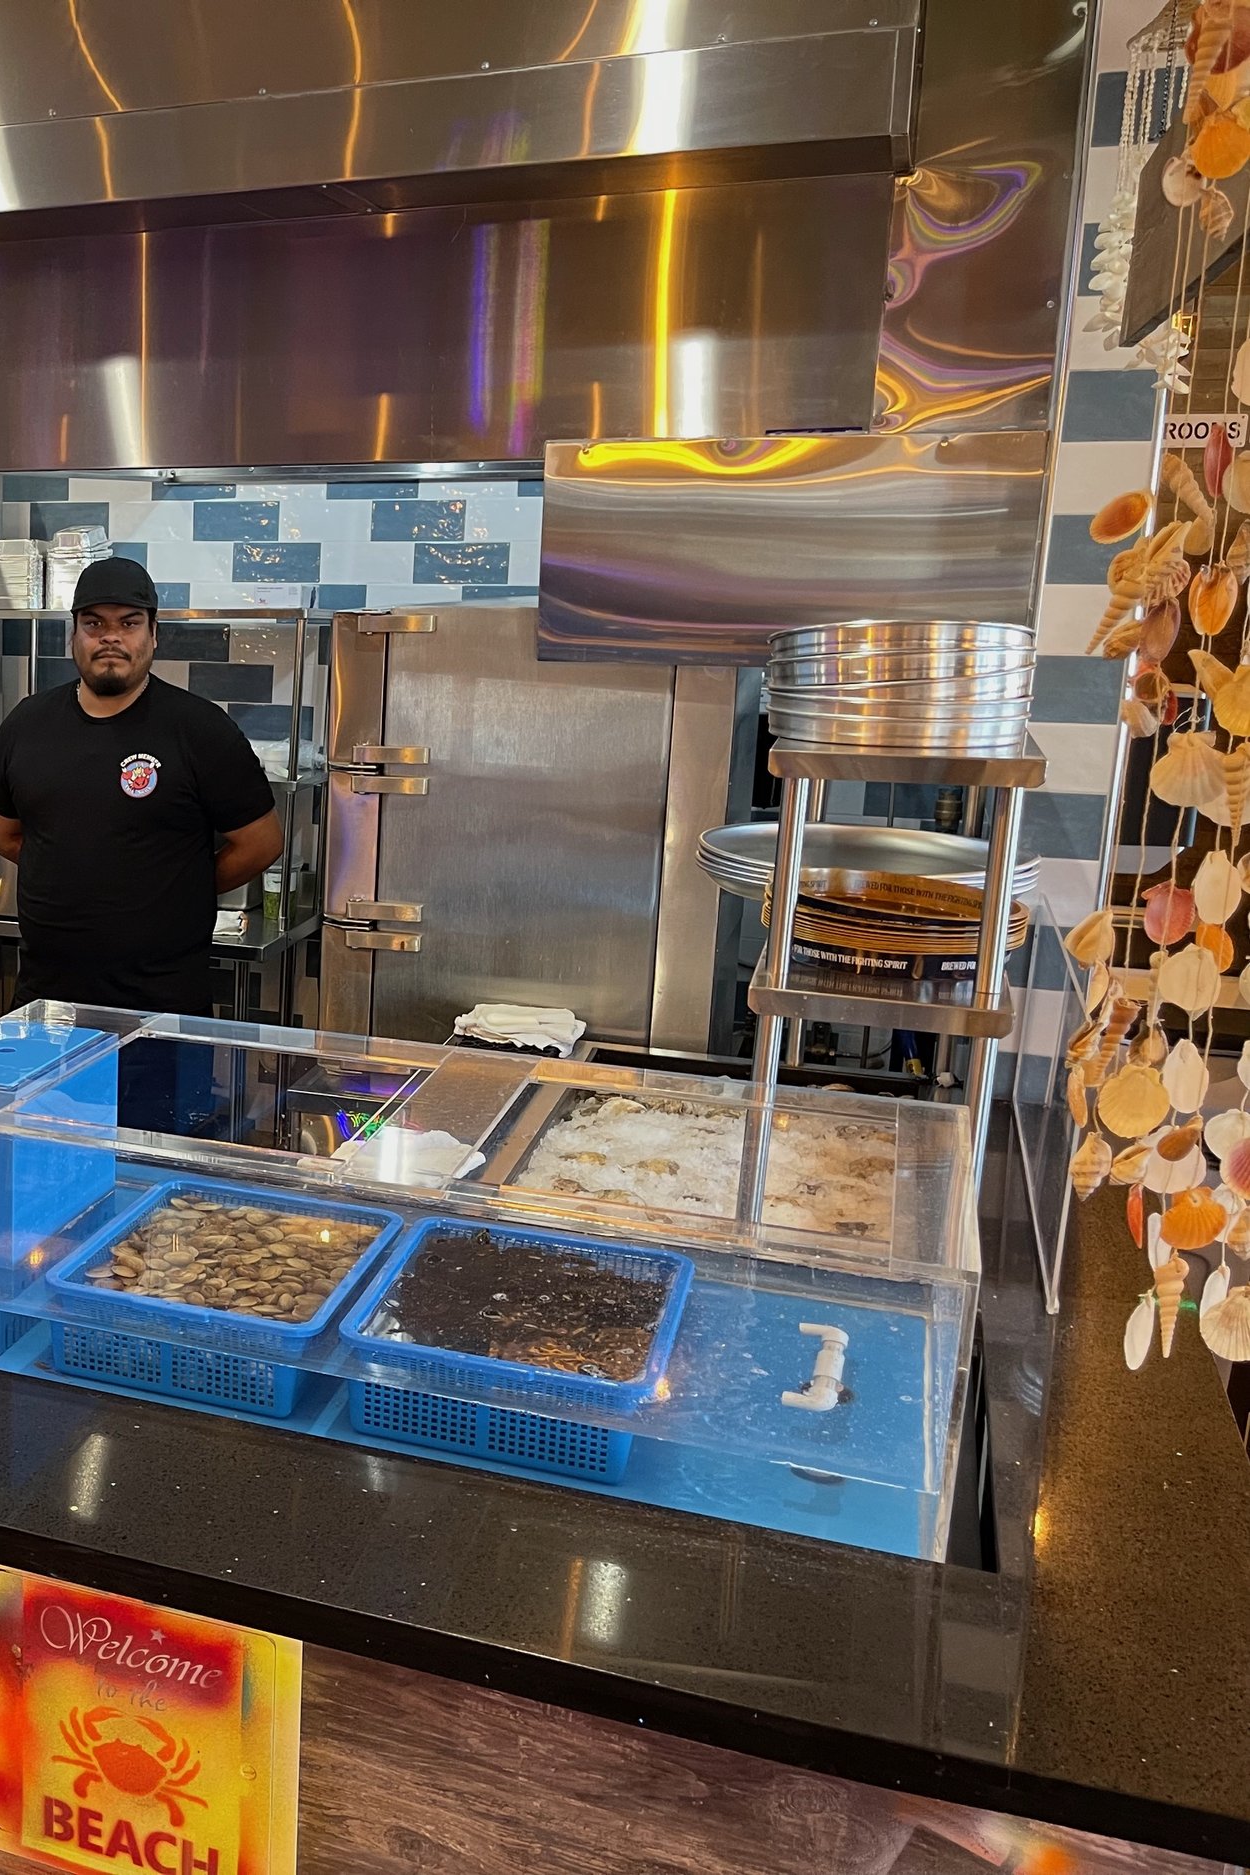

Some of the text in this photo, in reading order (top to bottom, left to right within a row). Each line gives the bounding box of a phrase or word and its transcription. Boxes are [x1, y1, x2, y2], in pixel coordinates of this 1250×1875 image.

[1163, 421, 1241, 440] ROOS
[803, 946, 820, 959] THOSE
[820, 951, 837, 962] WITH
[837, 953, 851, 965] THE
[851, 956, 884, 968] FIGHTING
[883, 960, 908, 971] SPIRIT
[941, 961, 967, 971] BREWED
[40, 1604, 223, 1689] Welcome
[42, 1795, 219, 1875] BEACH
